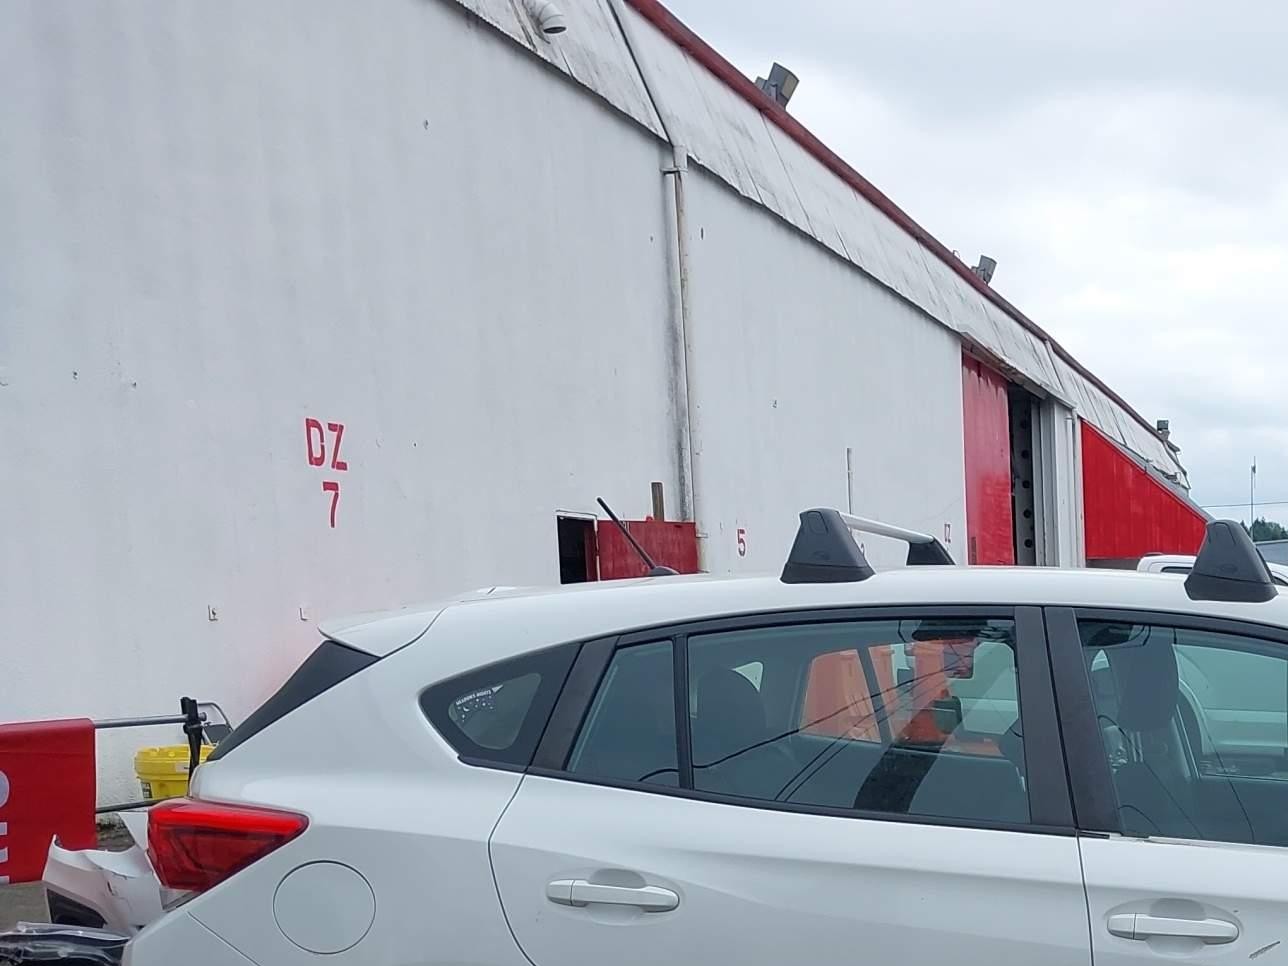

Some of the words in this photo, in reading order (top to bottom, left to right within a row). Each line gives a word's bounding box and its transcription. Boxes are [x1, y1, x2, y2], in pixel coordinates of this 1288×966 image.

[305, 418, 348, 471] DZ
[322, 481, 340, 528] 7
[737, 528, 746, 557] 5
